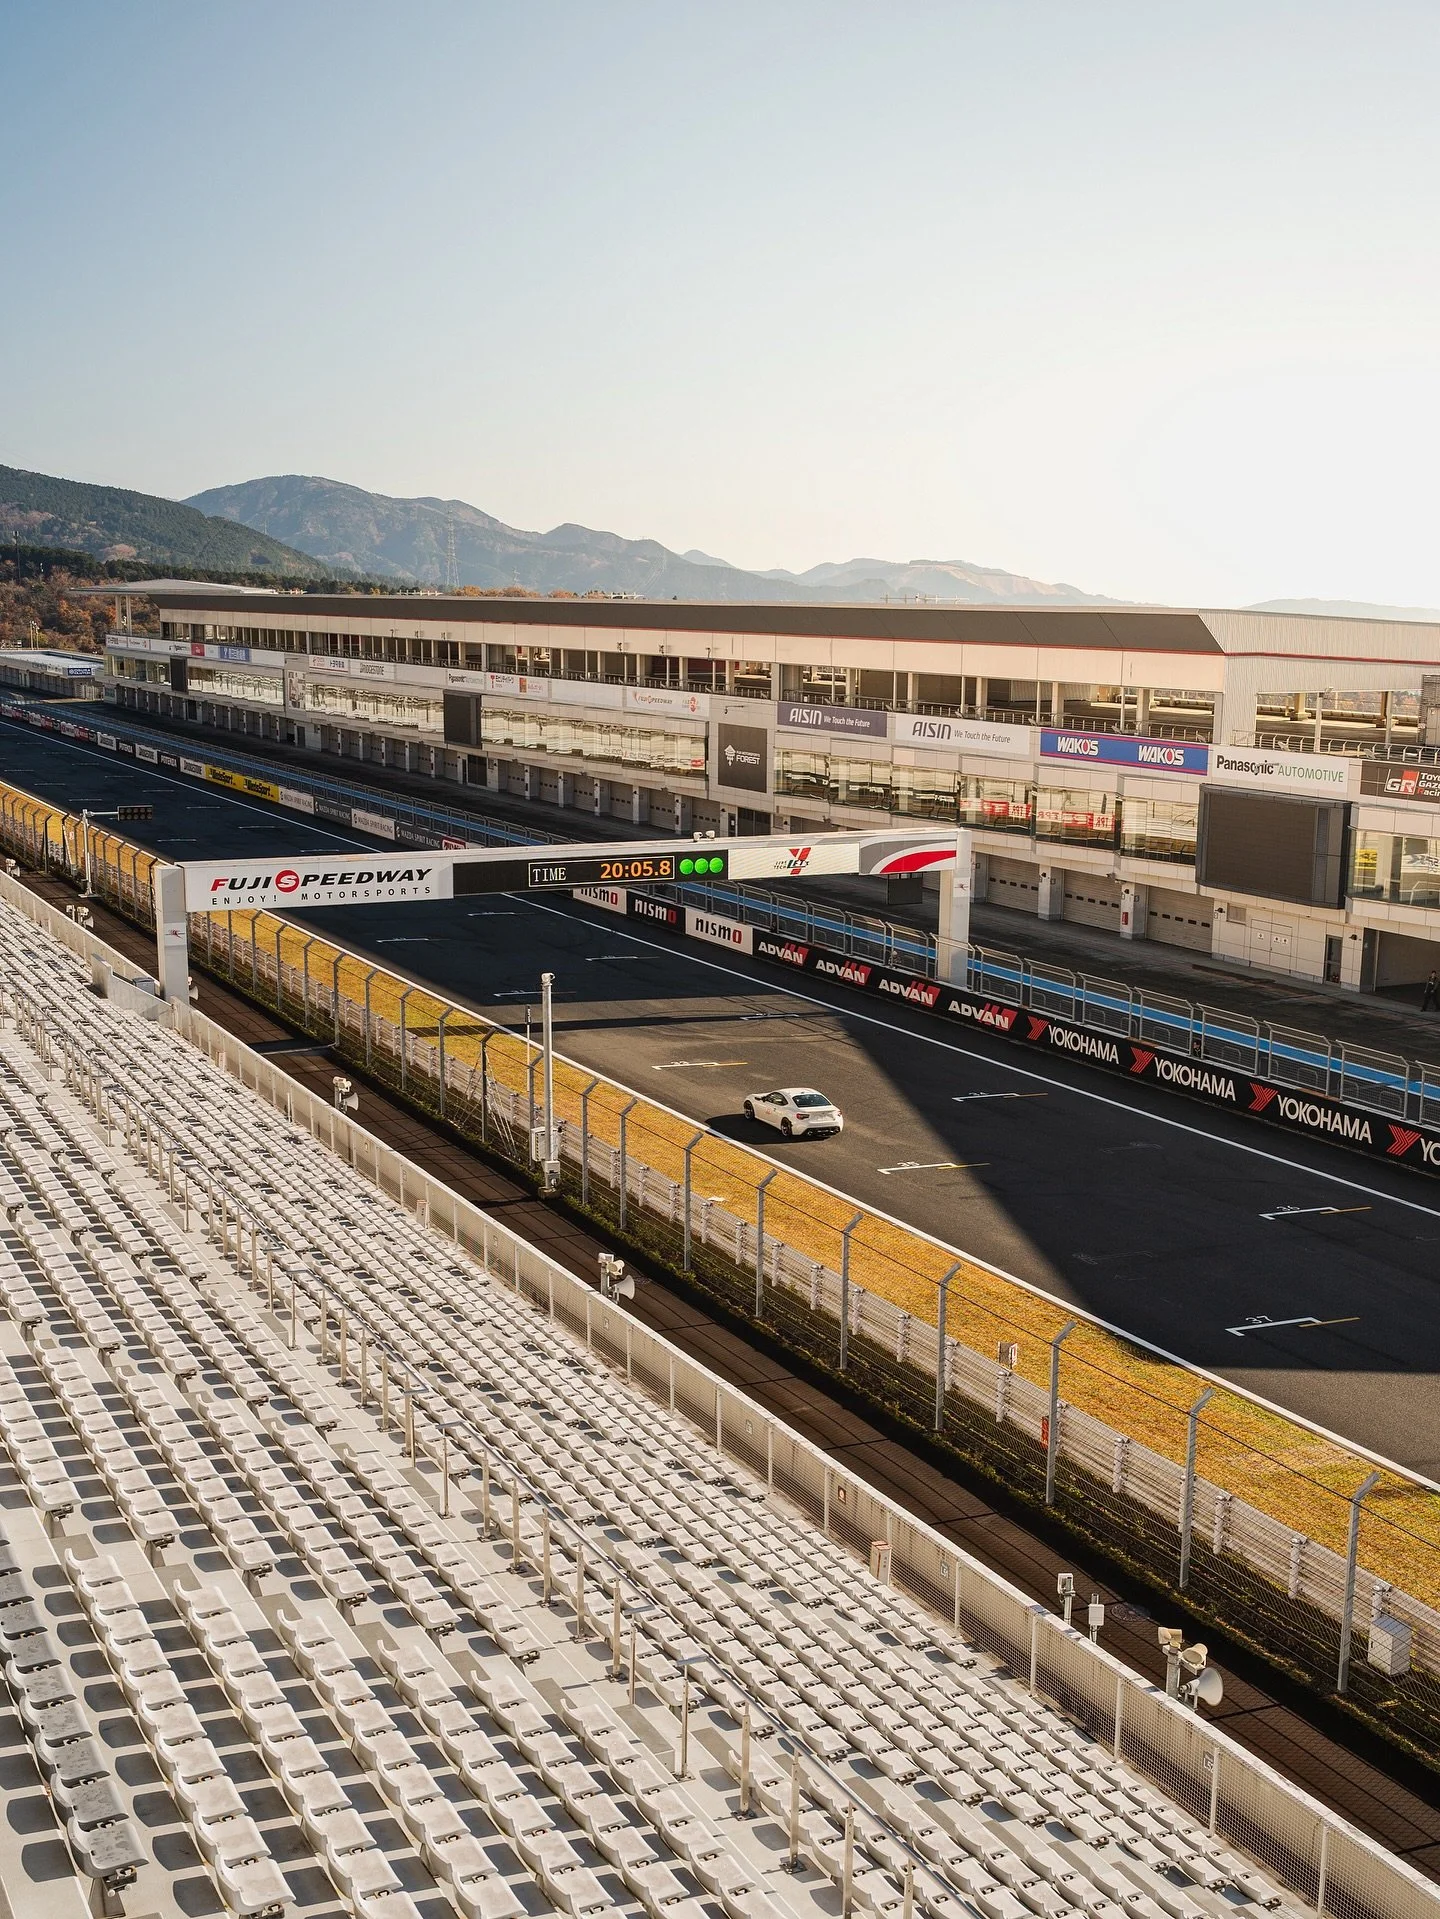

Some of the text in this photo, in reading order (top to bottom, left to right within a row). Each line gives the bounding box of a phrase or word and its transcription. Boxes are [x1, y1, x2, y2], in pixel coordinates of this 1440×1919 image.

[789, 707, 871, 728] AISIN We Touch the Future
[912, 721, 1011, 744] AISIN We Touch the Future
[736, 755, 761, 765] FOREST
[1216, 754, 1344, 783] Panasonic AUTOMOTIVE
[1386, 778, 1416, 793] GR
[319, 805, 351, 821] MAZDA SPIRIT RACING
[357, 815, 393, 834] MAZDA SPIRIT RACING
[402, 828, 414, 839] MAZDA
[414, 831, 425, 843] SPIRIT
[425, 835, 441, 849] RACING
[532, 860, 671, 882] TIME 20:05.8
[211, 886, 431, 905] ENJOY! MOTORSPORTS
[634, 898, 677, 925] nismo
[695, 916, 743, 944] nismo
[758, 941, 803, 965] ADVAN
[815, 959, 866, 984] ADVAN
[878, 978, 934, 1005] ADVAN
[948, 1000, 1009, 1028] ADVAN
[1048, 1025, 1119, 1065] YOKOHAMA
[1154, 1057, 1237, 1101] YOKOHAMA
[1277, 1094, 1373, 1144] YOKOHAMA
[1244, 1315, 1273, 1324] 37
